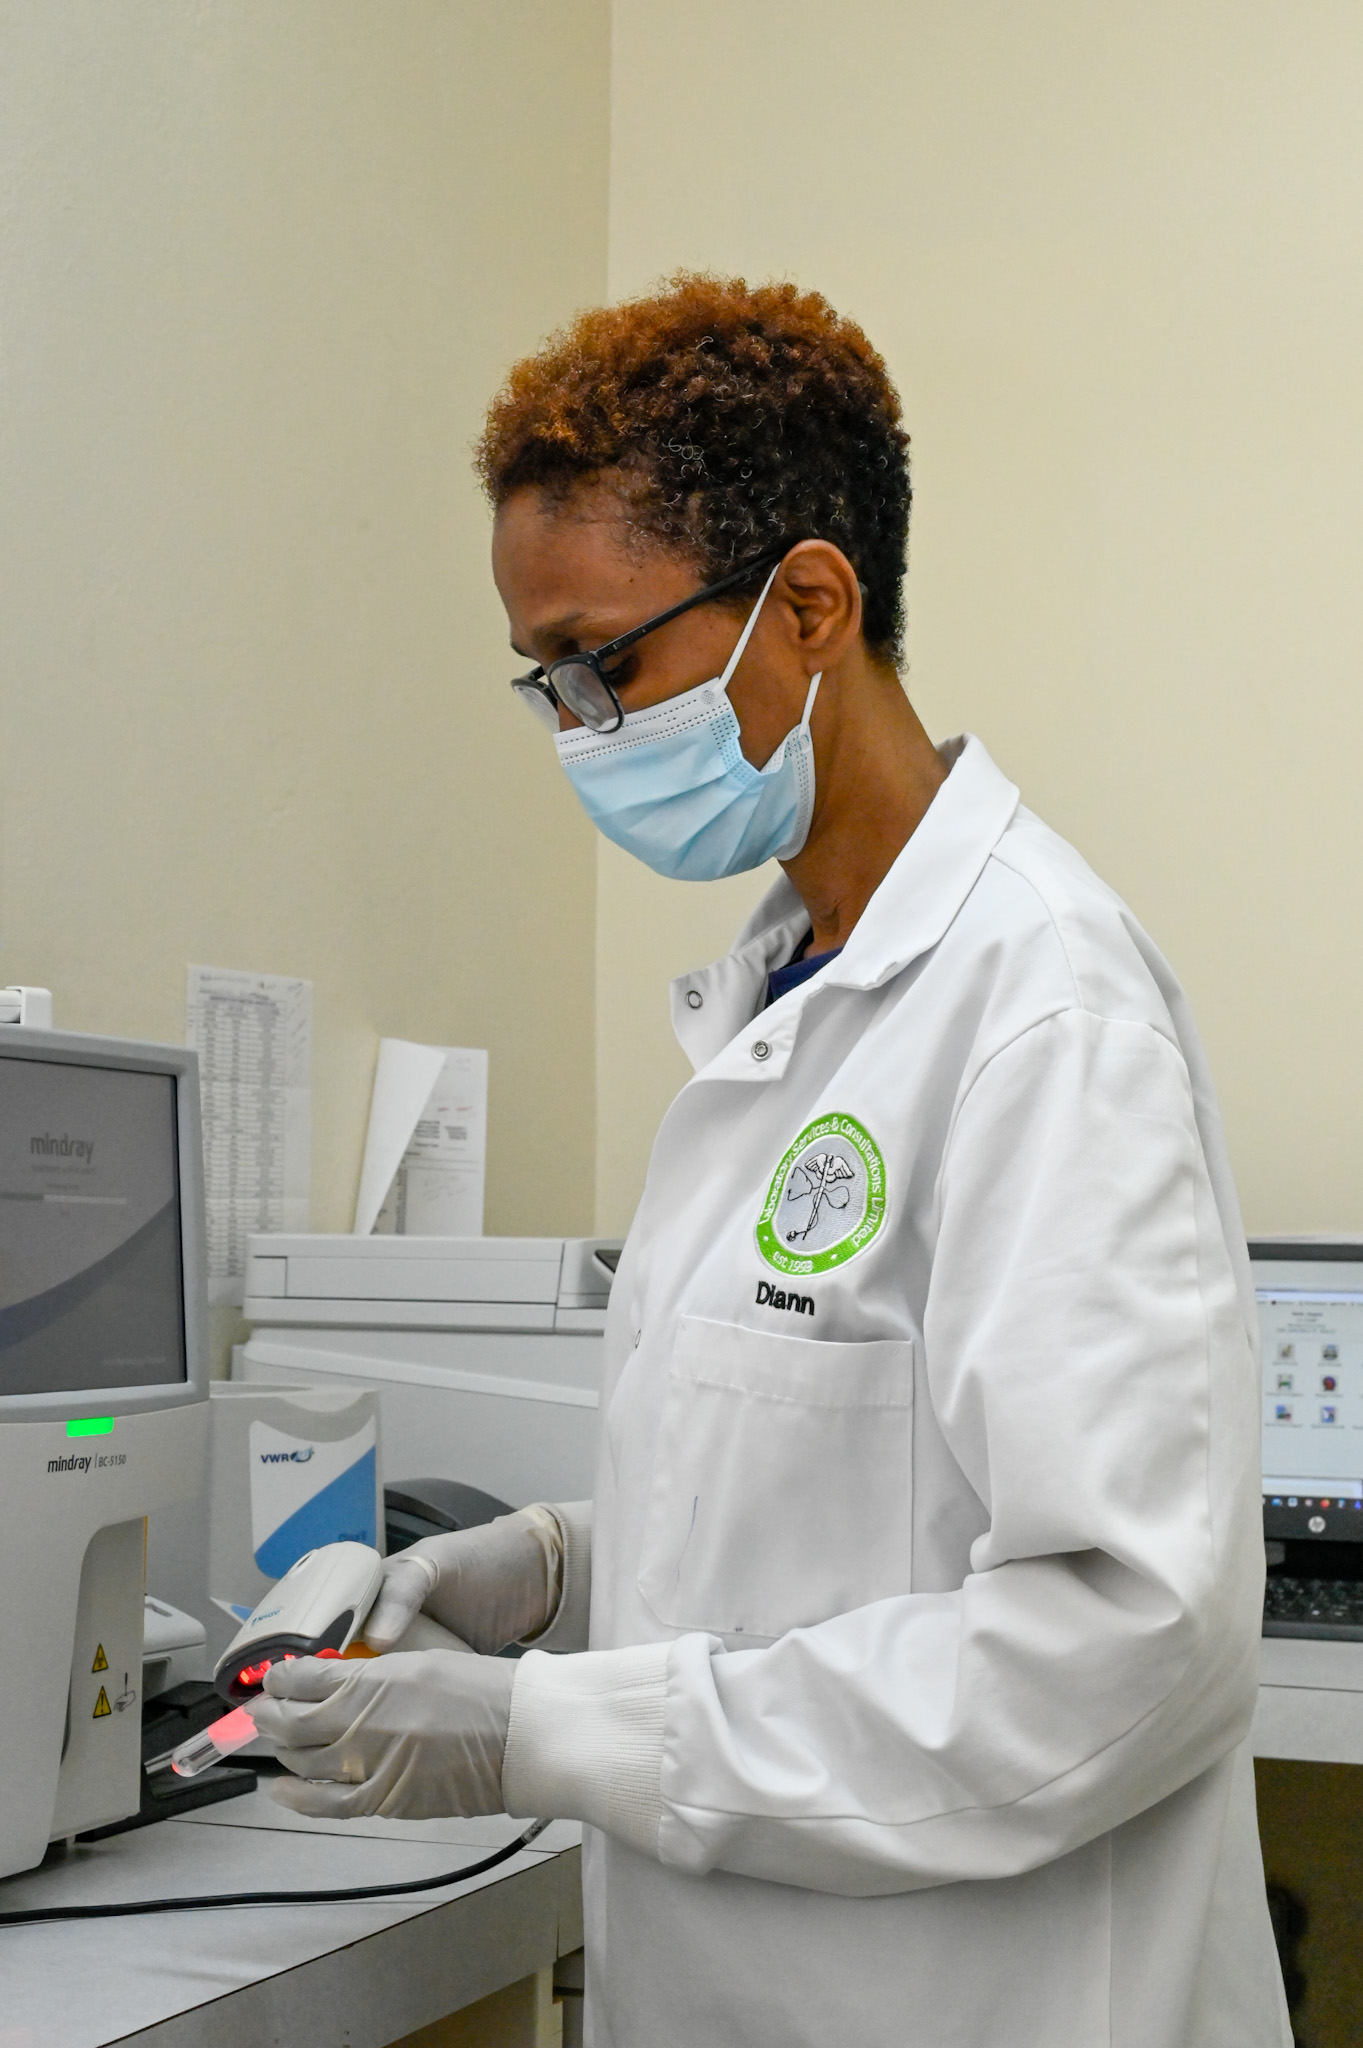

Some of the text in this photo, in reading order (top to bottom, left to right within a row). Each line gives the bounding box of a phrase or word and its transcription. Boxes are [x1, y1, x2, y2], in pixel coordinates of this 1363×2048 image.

[30, 1132, 95, 1164] mindray
[758, 1116, 884, 1247] Laboratory Services & Consultations Limited
[755, 1280, 815, 1316] Diann
[47, 1454, 92, 1474] mindray
[260, 1453, 289, 1464] VWR
